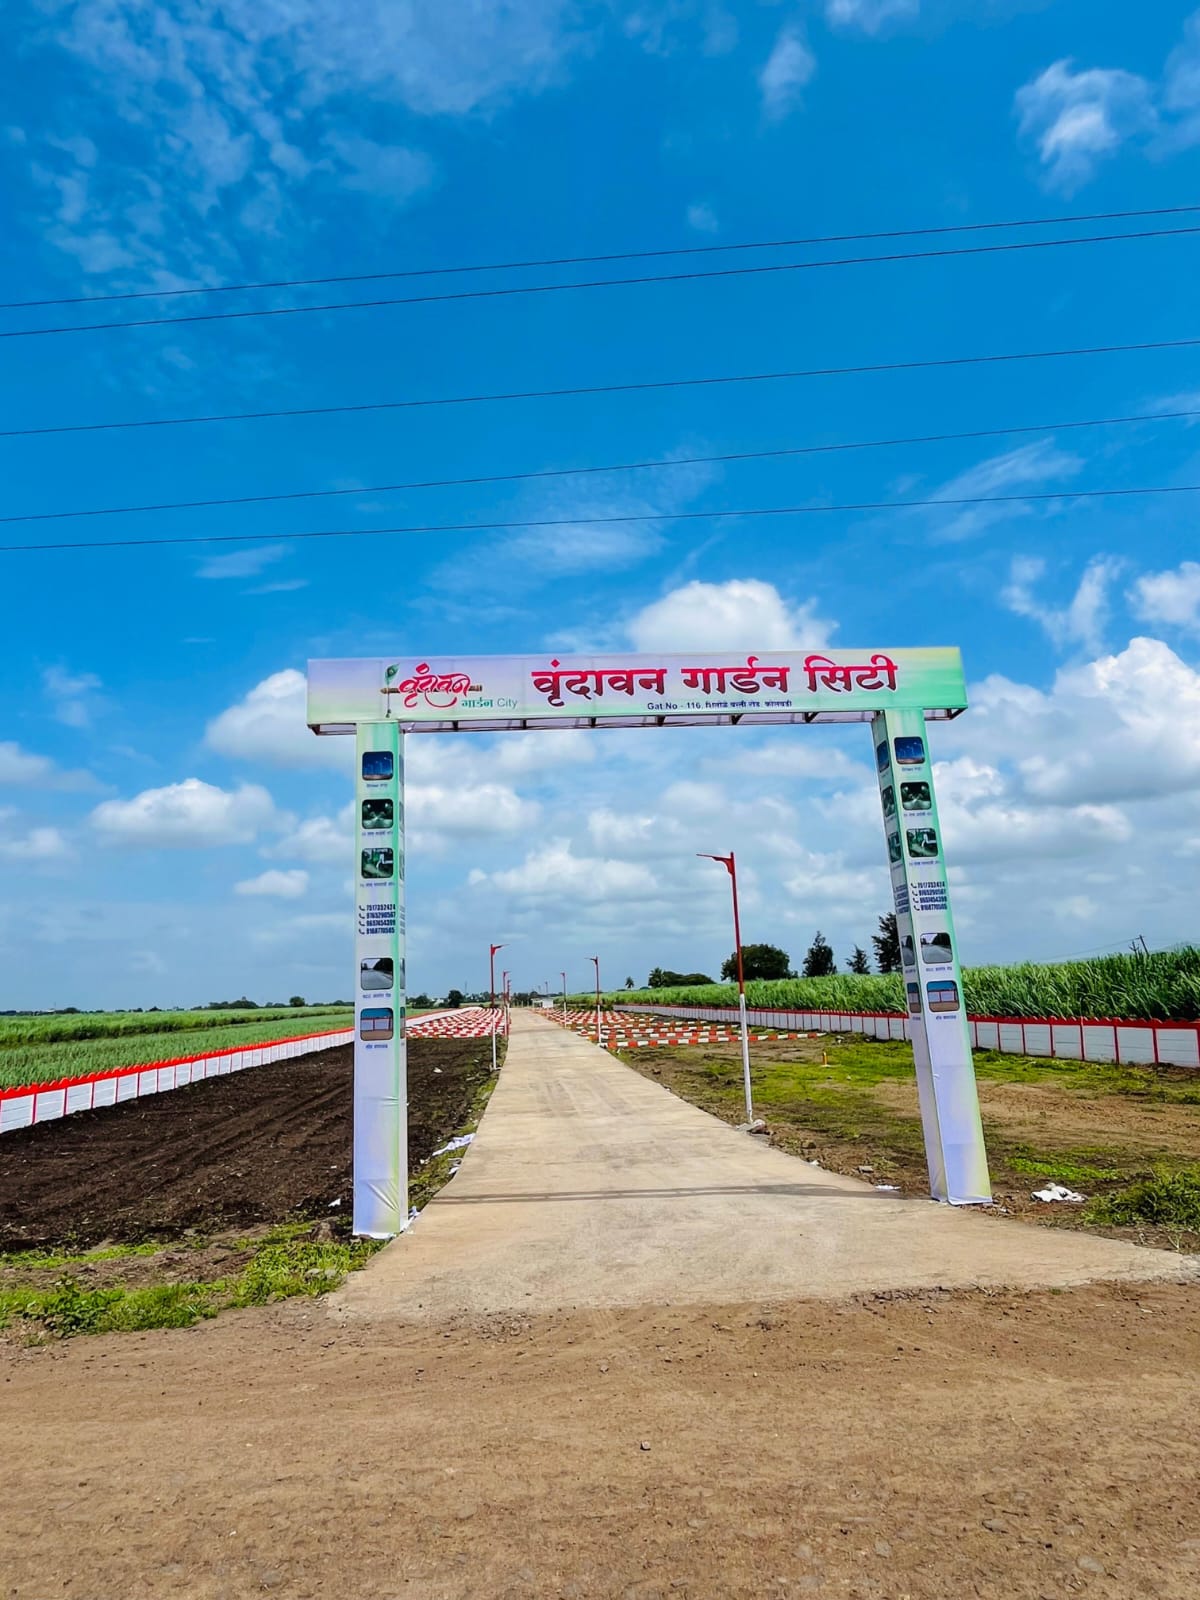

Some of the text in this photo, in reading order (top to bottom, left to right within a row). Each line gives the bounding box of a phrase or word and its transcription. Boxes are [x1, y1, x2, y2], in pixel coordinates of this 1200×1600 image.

[531, 654, 898, 707] वृंदावन गार्डन सिटी
[497, 697, 518, 710] City
[647, 701, 663, 710] Gat
[665, 701, 678, 710] No
